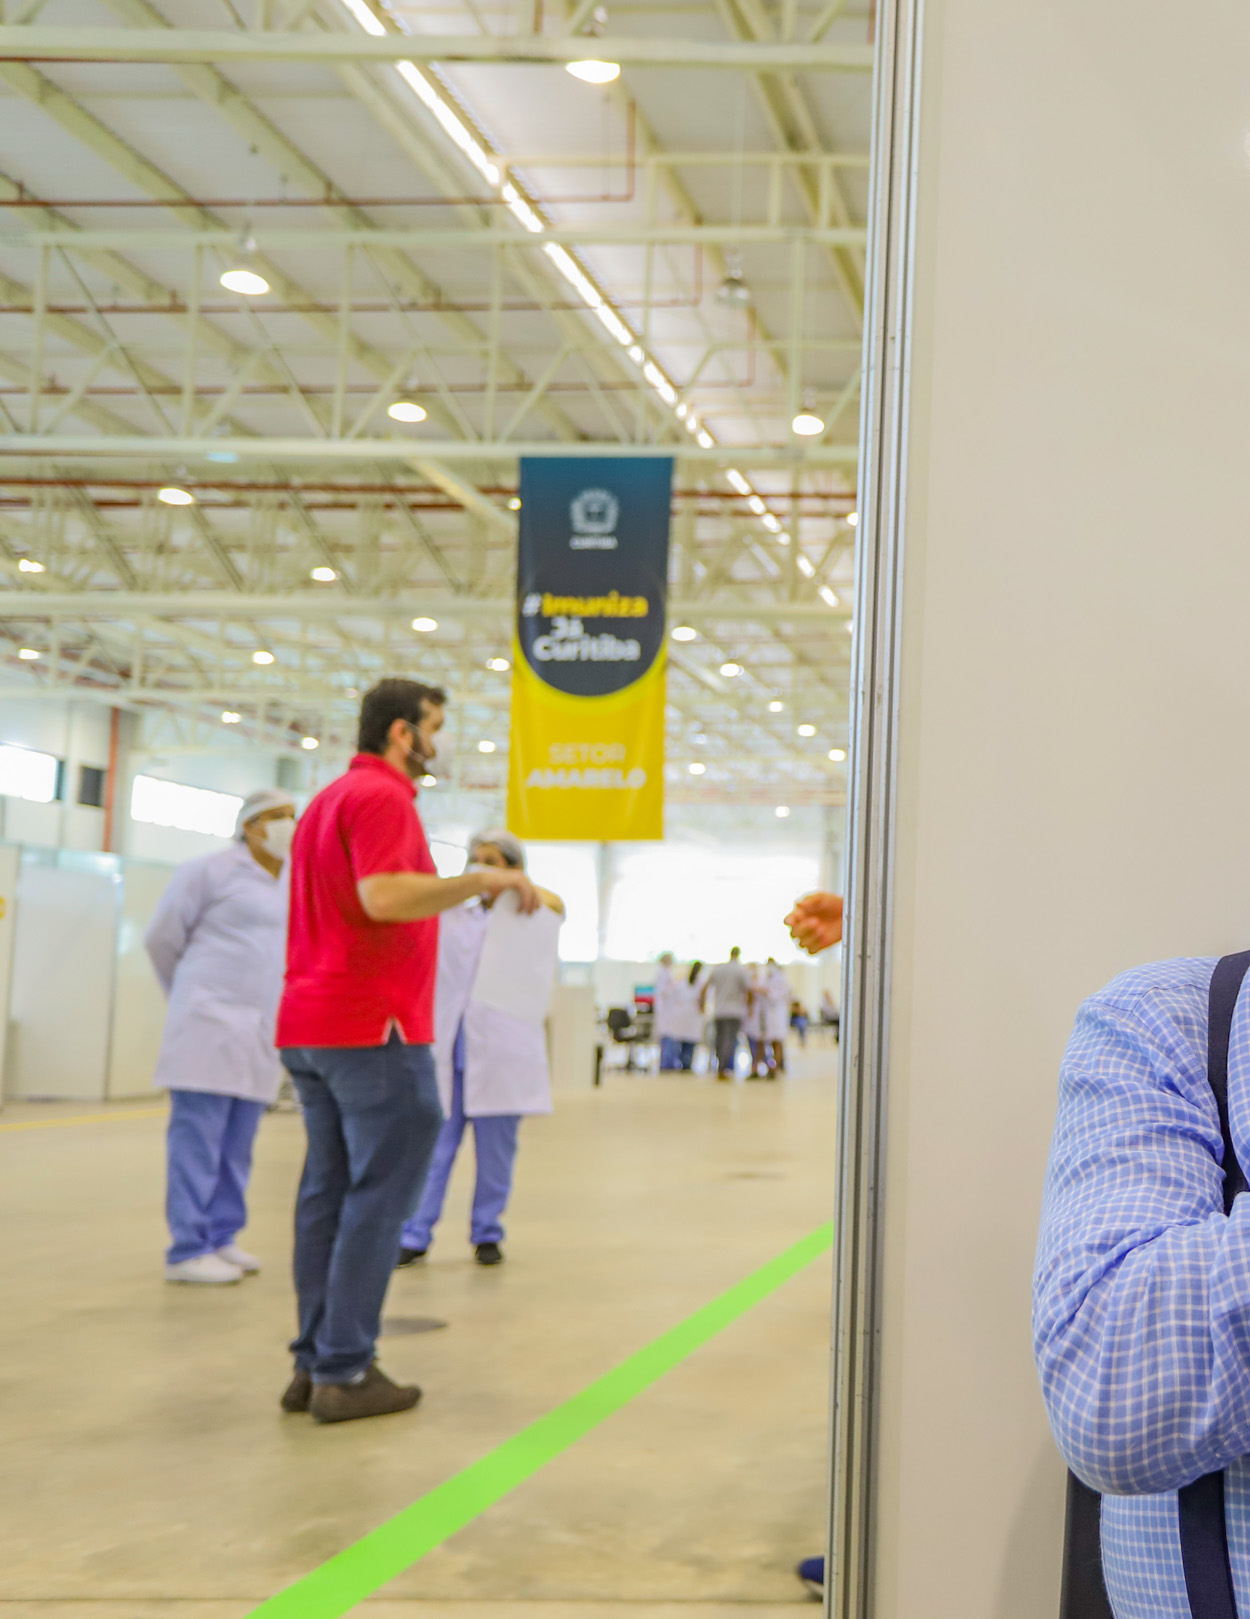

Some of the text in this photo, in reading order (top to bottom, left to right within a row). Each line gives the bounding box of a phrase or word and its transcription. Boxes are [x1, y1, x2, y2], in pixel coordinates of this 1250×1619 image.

[522, 590, 648, 617] #Imuniza
[532, 634, 641, 661] Curitiba
[548, 742, 626, 765] SETOR
[526, 767, 647, 790] AMARELO
